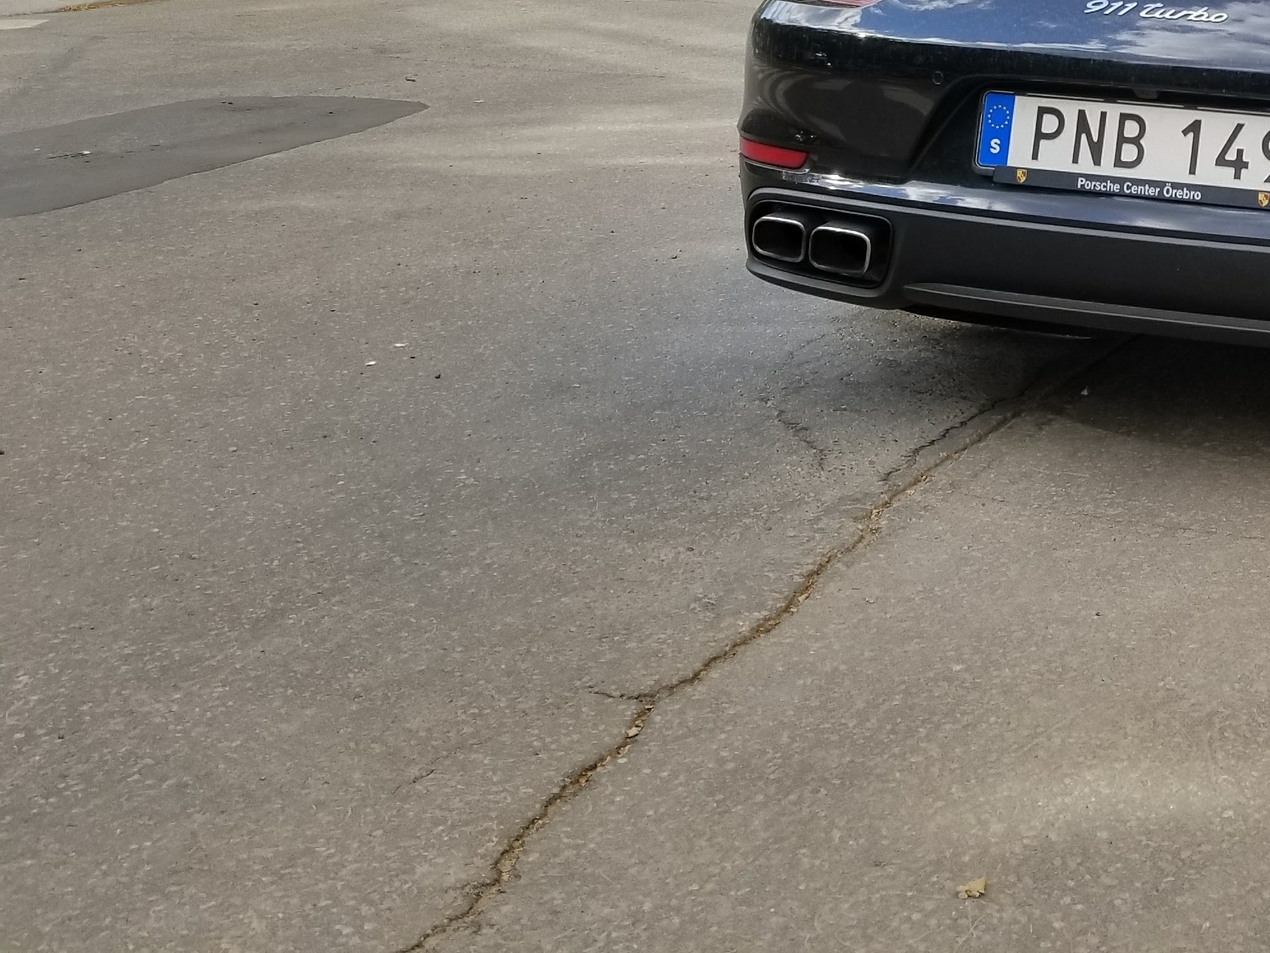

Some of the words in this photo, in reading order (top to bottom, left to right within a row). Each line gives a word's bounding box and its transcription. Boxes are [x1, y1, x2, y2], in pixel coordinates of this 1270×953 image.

[1139, 2, 1229, 23] turbo
[989, 138, 1001, 155] S
[1031, 105, 1147, 169] PNB
[1077, 177, 1120, 192] Porsche
[1123, 181, 1160, 196] Center
[1163, 183, 1202, 200] Örebro
